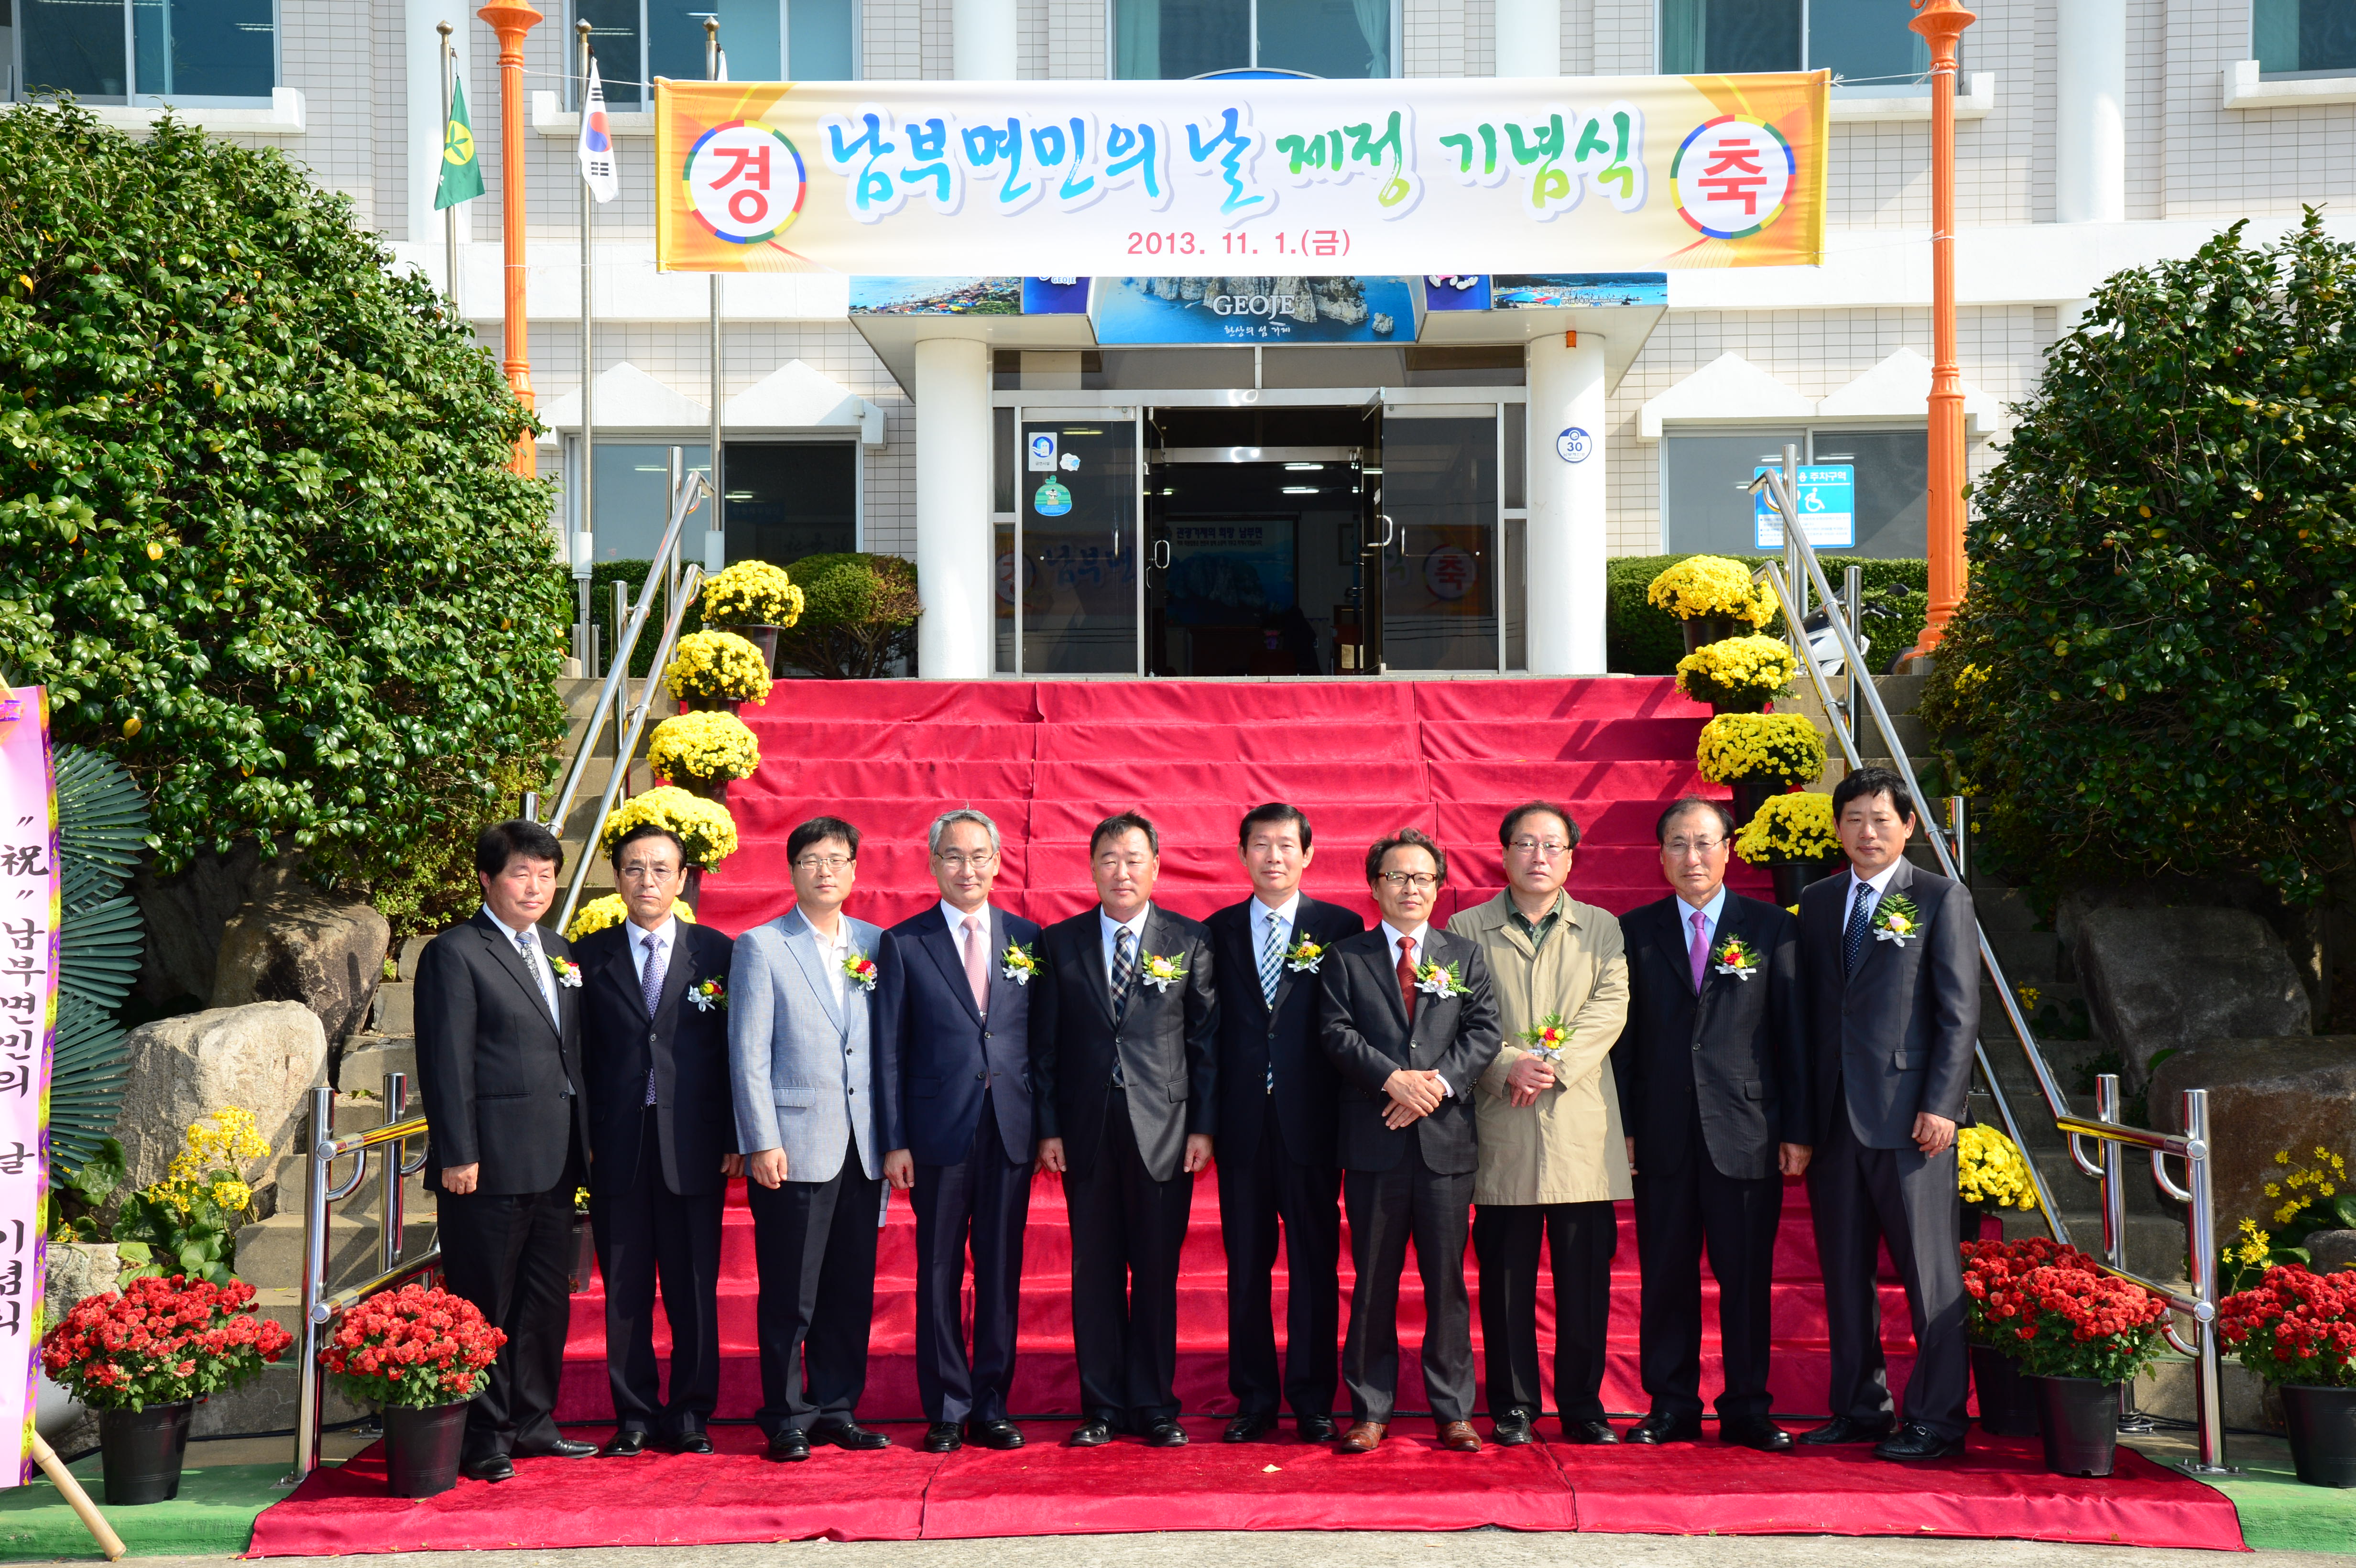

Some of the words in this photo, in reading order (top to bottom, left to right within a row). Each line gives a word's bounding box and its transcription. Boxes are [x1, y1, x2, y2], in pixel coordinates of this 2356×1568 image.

[827, 113, 1160, 211] 남부면민의
[1185, 107, 1265, 216] 날
[1276, 110, 1410, 207] 제정
[1439, 111, 1634, 209] 기념식
[708, 145, 770, 224] 경
[1697, 138, 1767, 215] 축
[1127, 232, 1205, 254] 2013.
[1222, 232, 1258, 254] 11.
[1212, 295, 1295, 320] GEOJE
[1567, 442, 1582, 451] 30
[1810, 471, 1847, 481] 주차구역
